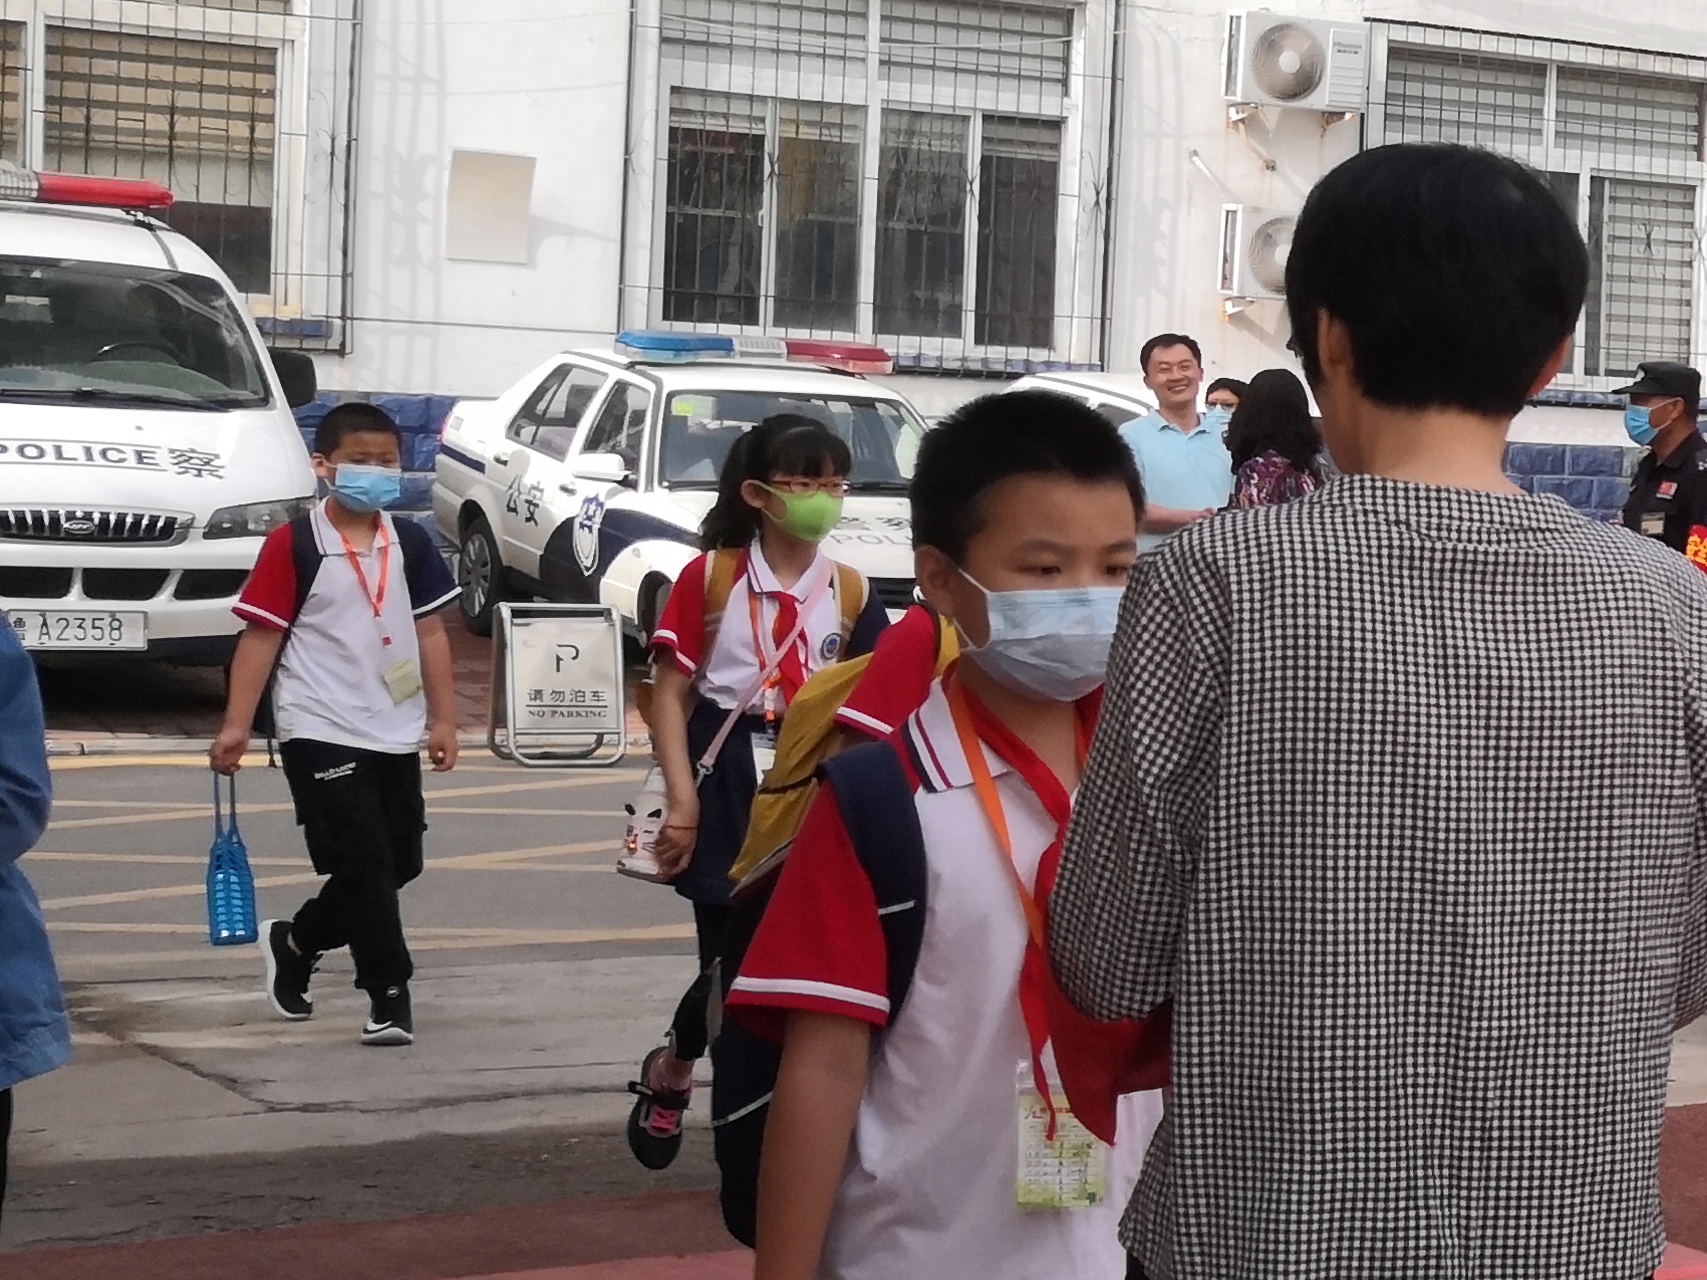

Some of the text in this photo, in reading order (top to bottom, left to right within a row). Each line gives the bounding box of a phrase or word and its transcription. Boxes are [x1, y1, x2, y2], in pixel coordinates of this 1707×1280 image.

[168, 447, 225, 480] 察
[506, 473, 545, 527] 公安
[527, 688, 607, 703] 请勿泊车
[528, 710, 607, 718] NO PARKING
